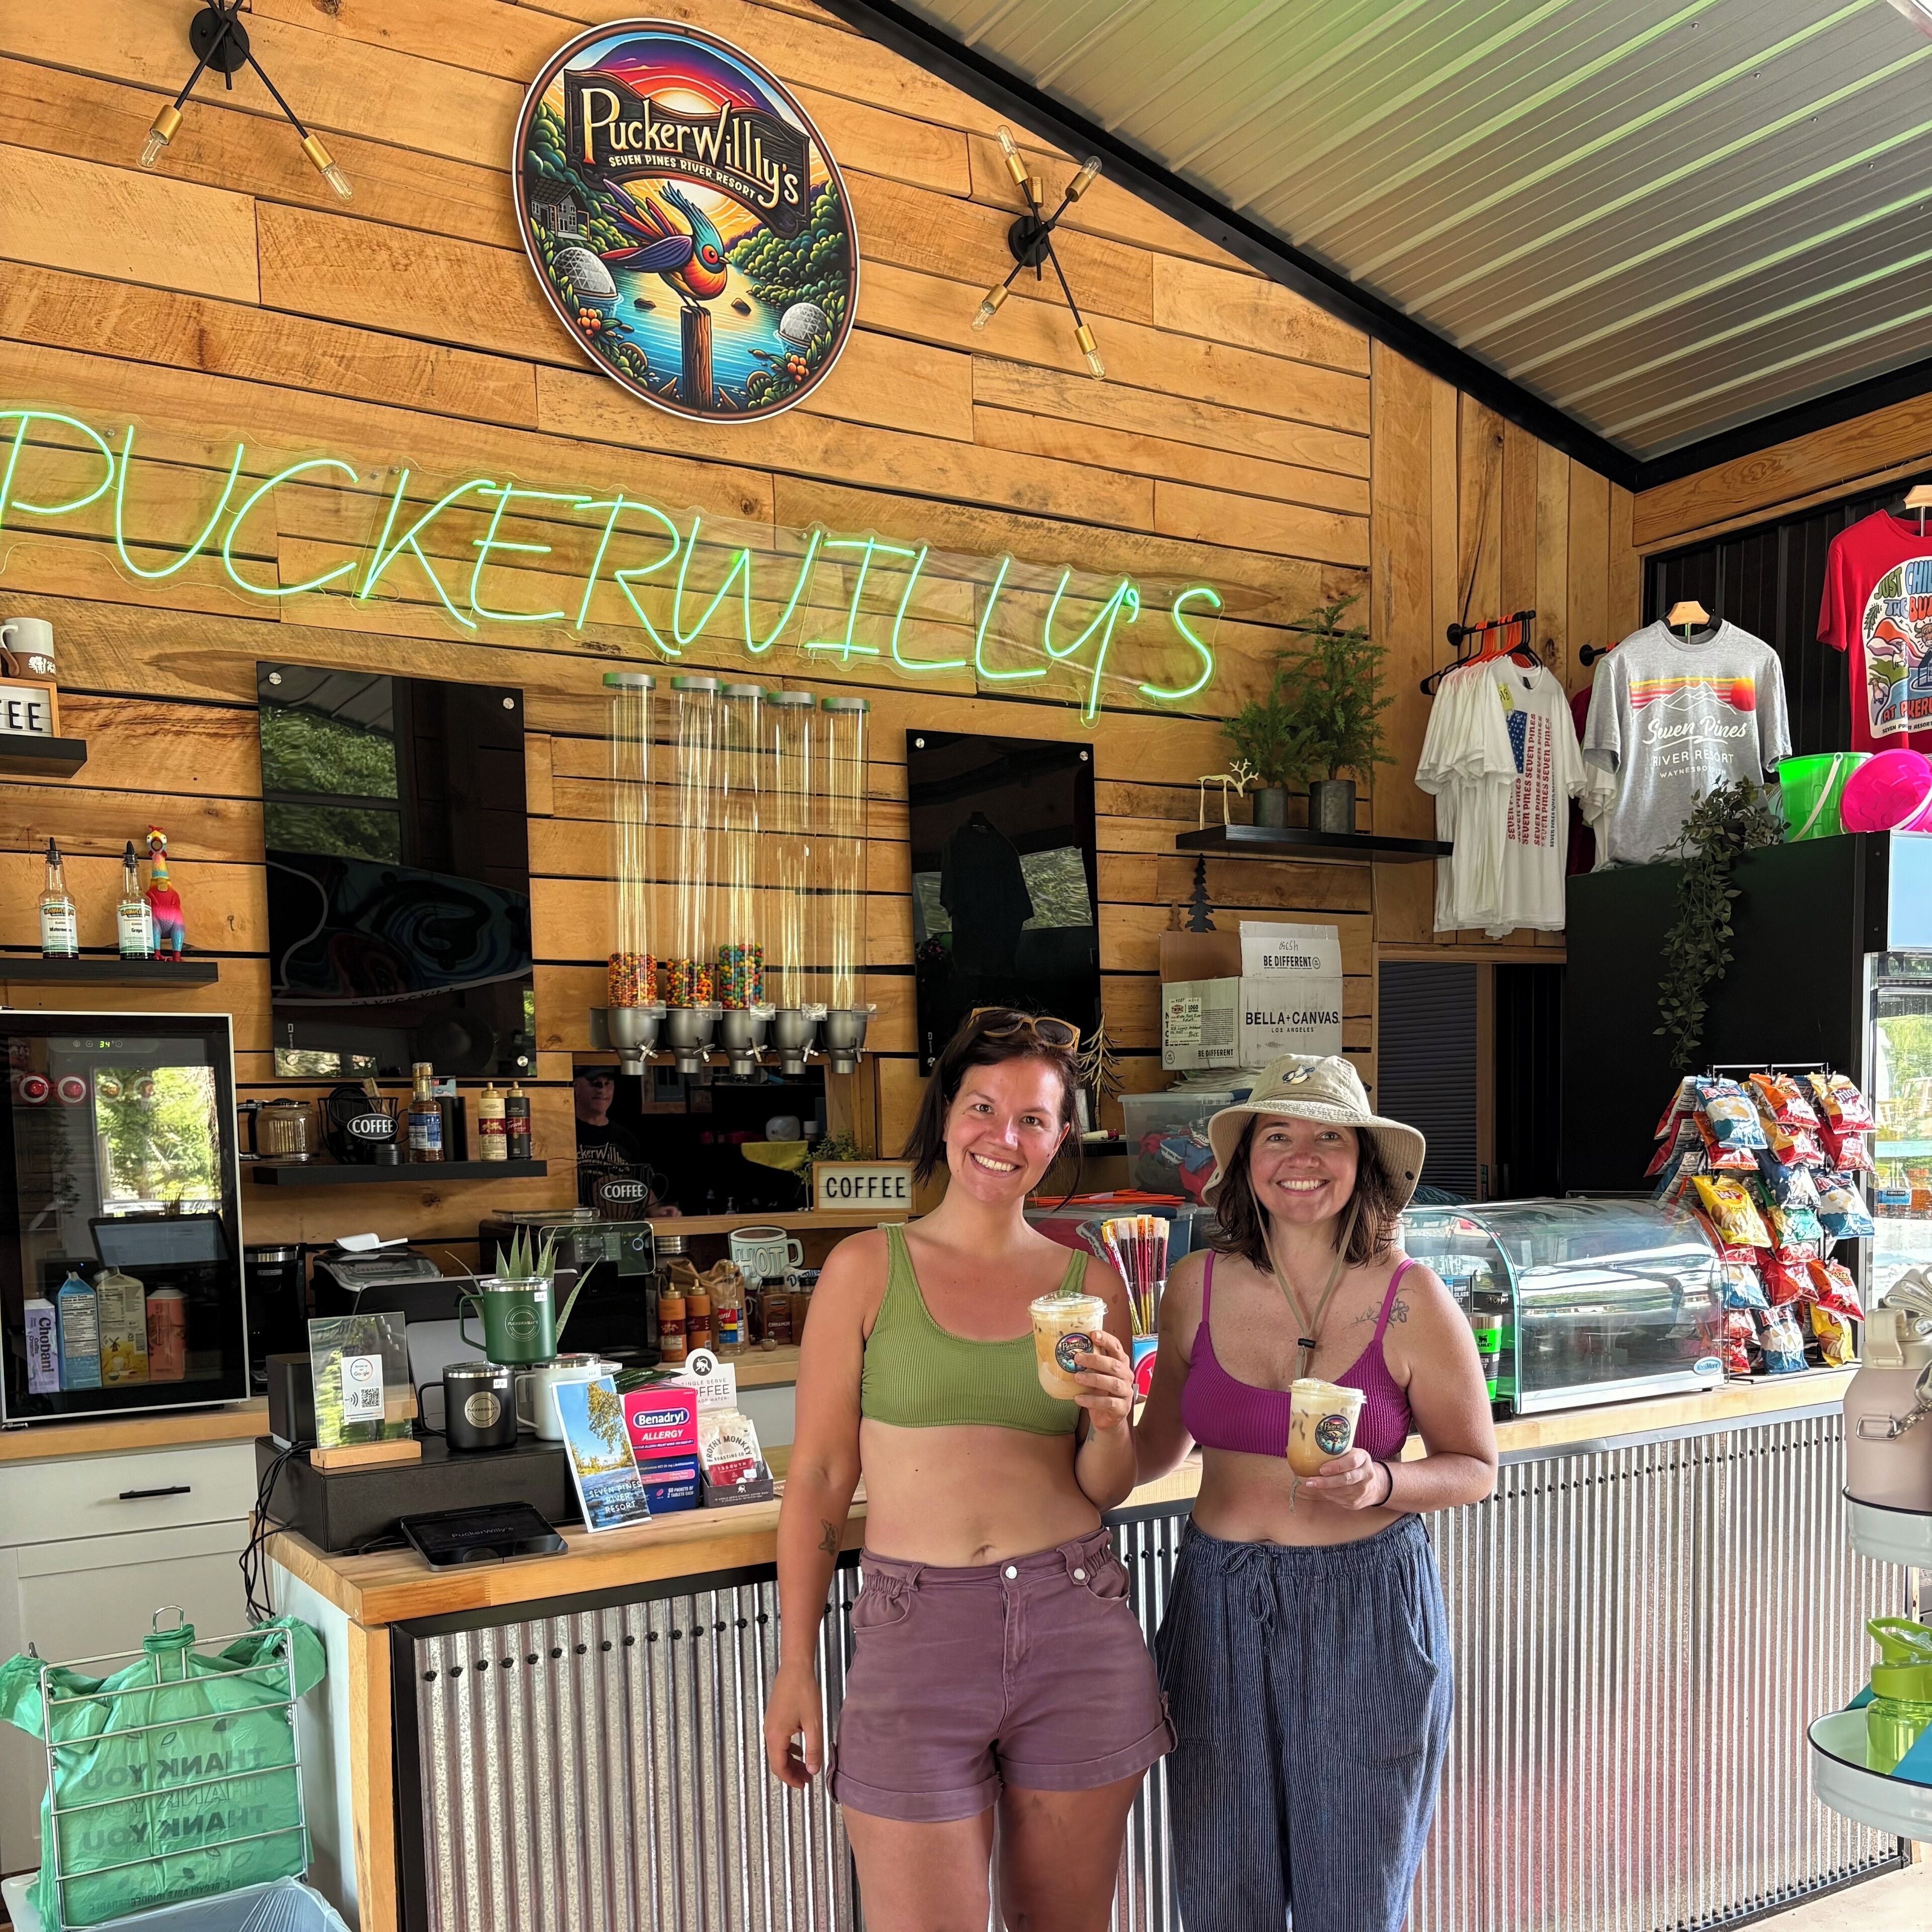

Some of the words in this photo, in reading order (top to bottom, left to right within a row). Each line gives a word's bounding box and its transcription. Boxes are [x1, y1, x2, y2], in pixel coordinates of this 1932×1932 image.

[609, 154, 641, 167] SEVEN
[645, 154, 677, 169] PINES
[680, 159, 713, 179] RIVER
[715, 171, 756, 199] RESORT
[1874, 567, 1902, 600] JUST
[1883, 597, 1909, 619] THE
[0, 700, 43, 731] EE
[1883, 704, 1897, 723] AT
[1700, 715, 1747, 738] Pines
[1882, 725, 1896, 734] SEVEN
[1525, 746, 1535, 779] SEVEN
[1543, 750, 1551, 782] SEVEN
[1653, 751, 1689, 766] RIVER
[1695, 749, 1734, 764] RESORT
[1523, 780, 1532, 810] PINES
[1522, 812, 1530, 845] SEVEN
[1263, 955, 1272, 966] BE
[1275, 956, 1311, 967] DIFFERENT
[1246, 1011, 1338, 1025] BELLA+CANVAS
[352, 1118, 393, 1134] COFFEE
[604, 1185, 643, 1198] COFFEE
[827, 1176, 905, 1198] COFFEE
[736, 1246, 784, 1278] HOT
[39, 1317, 54, 1373] Chobani
[696, 1384, 730, 1397] FFEE
[638, 1411, 684, 1426] Benadryl
[641, 1429, 684, 1441] ALLERGY
[706, 1438, 721, 1462] FROTHY
[723, 1435, 753, 1455] MONKEY
[590, 1487, 614, 1498] SEVEN
[618, 1481, 641, 1492] PINES
[606, 1493, 630, 1504] RIVER
[605, 1500, 635, 1514] RESORT
